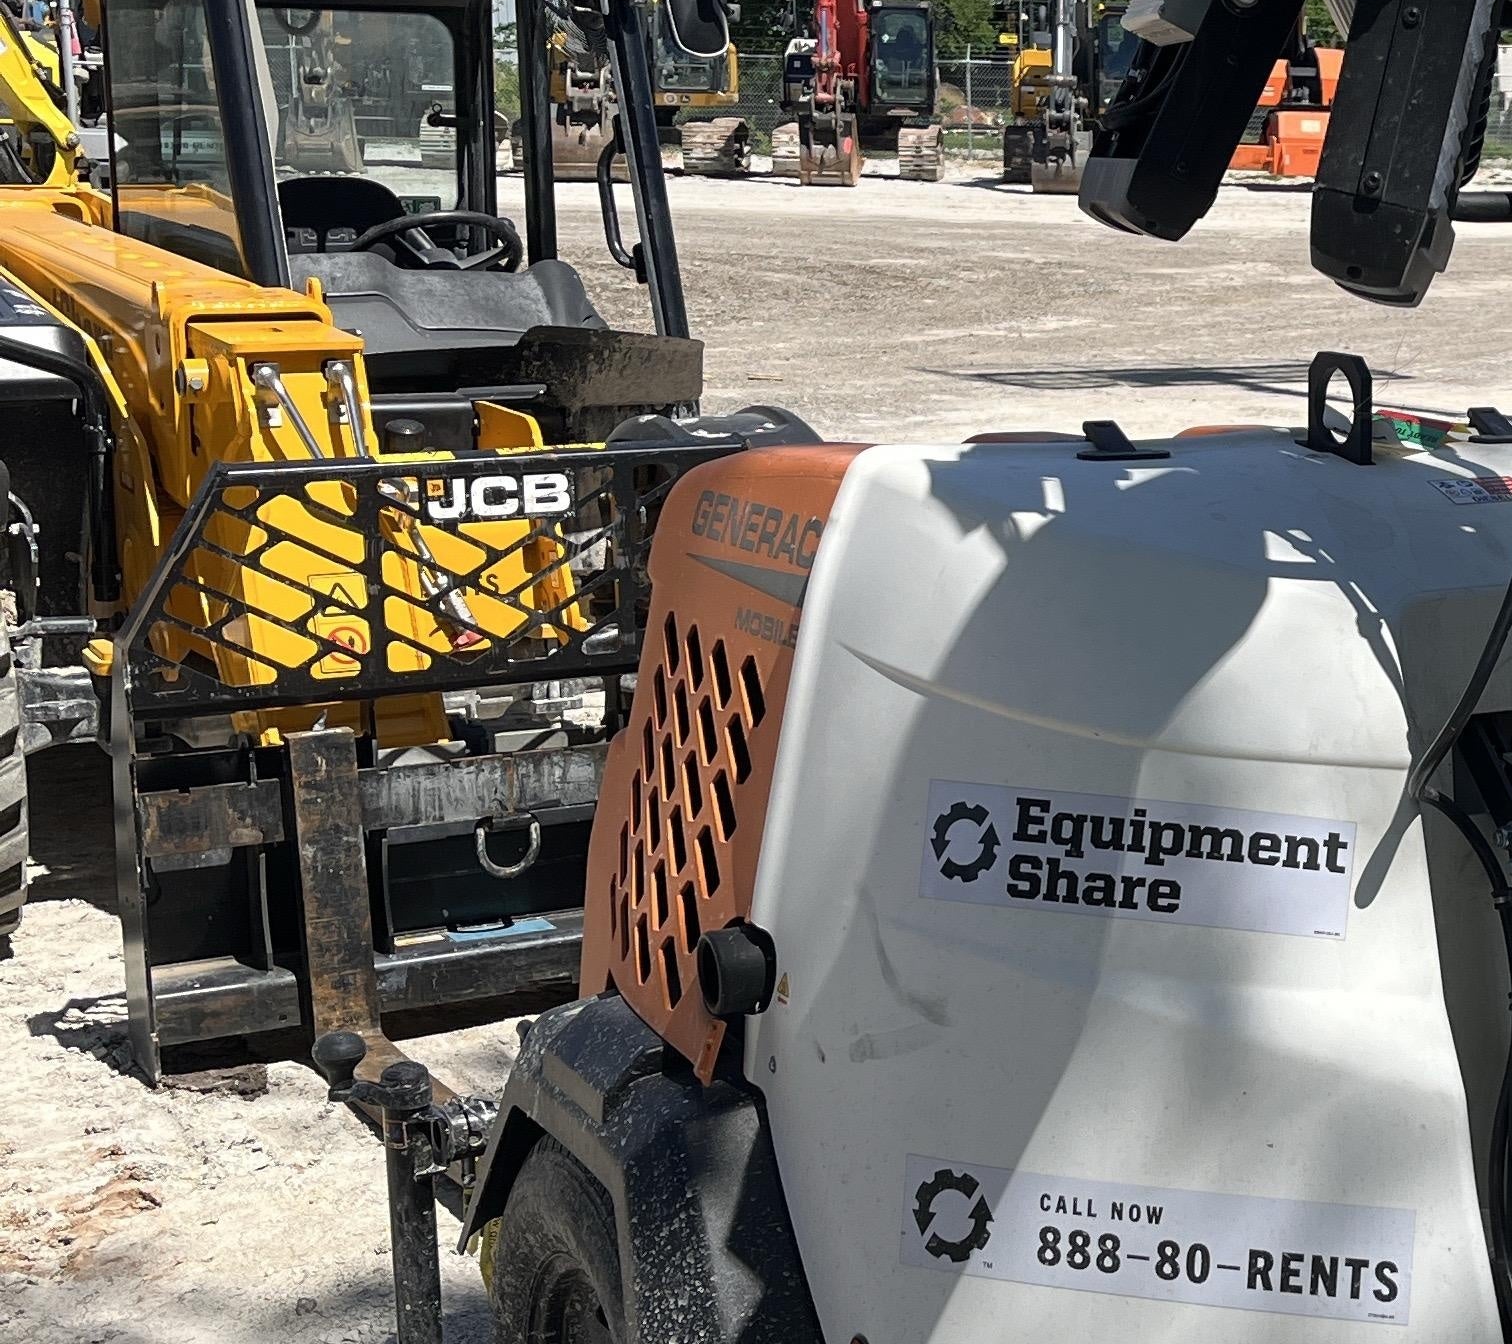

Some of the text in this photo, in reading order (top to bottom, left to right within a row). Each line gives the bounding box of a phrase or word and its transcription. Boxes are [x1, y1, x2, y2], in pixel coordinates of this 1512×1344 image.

[426, 472, 571, 520] JCB
[691, 489, 826, 570] GENERAC
[1012, 796, 1349, 875] Equipment
[1006, 853, 1182, 914] Share
[1039, 1193, 1165, 1226] CALL NOW
[1036, 1225, 1400, 1304] 888-80-RENTS
